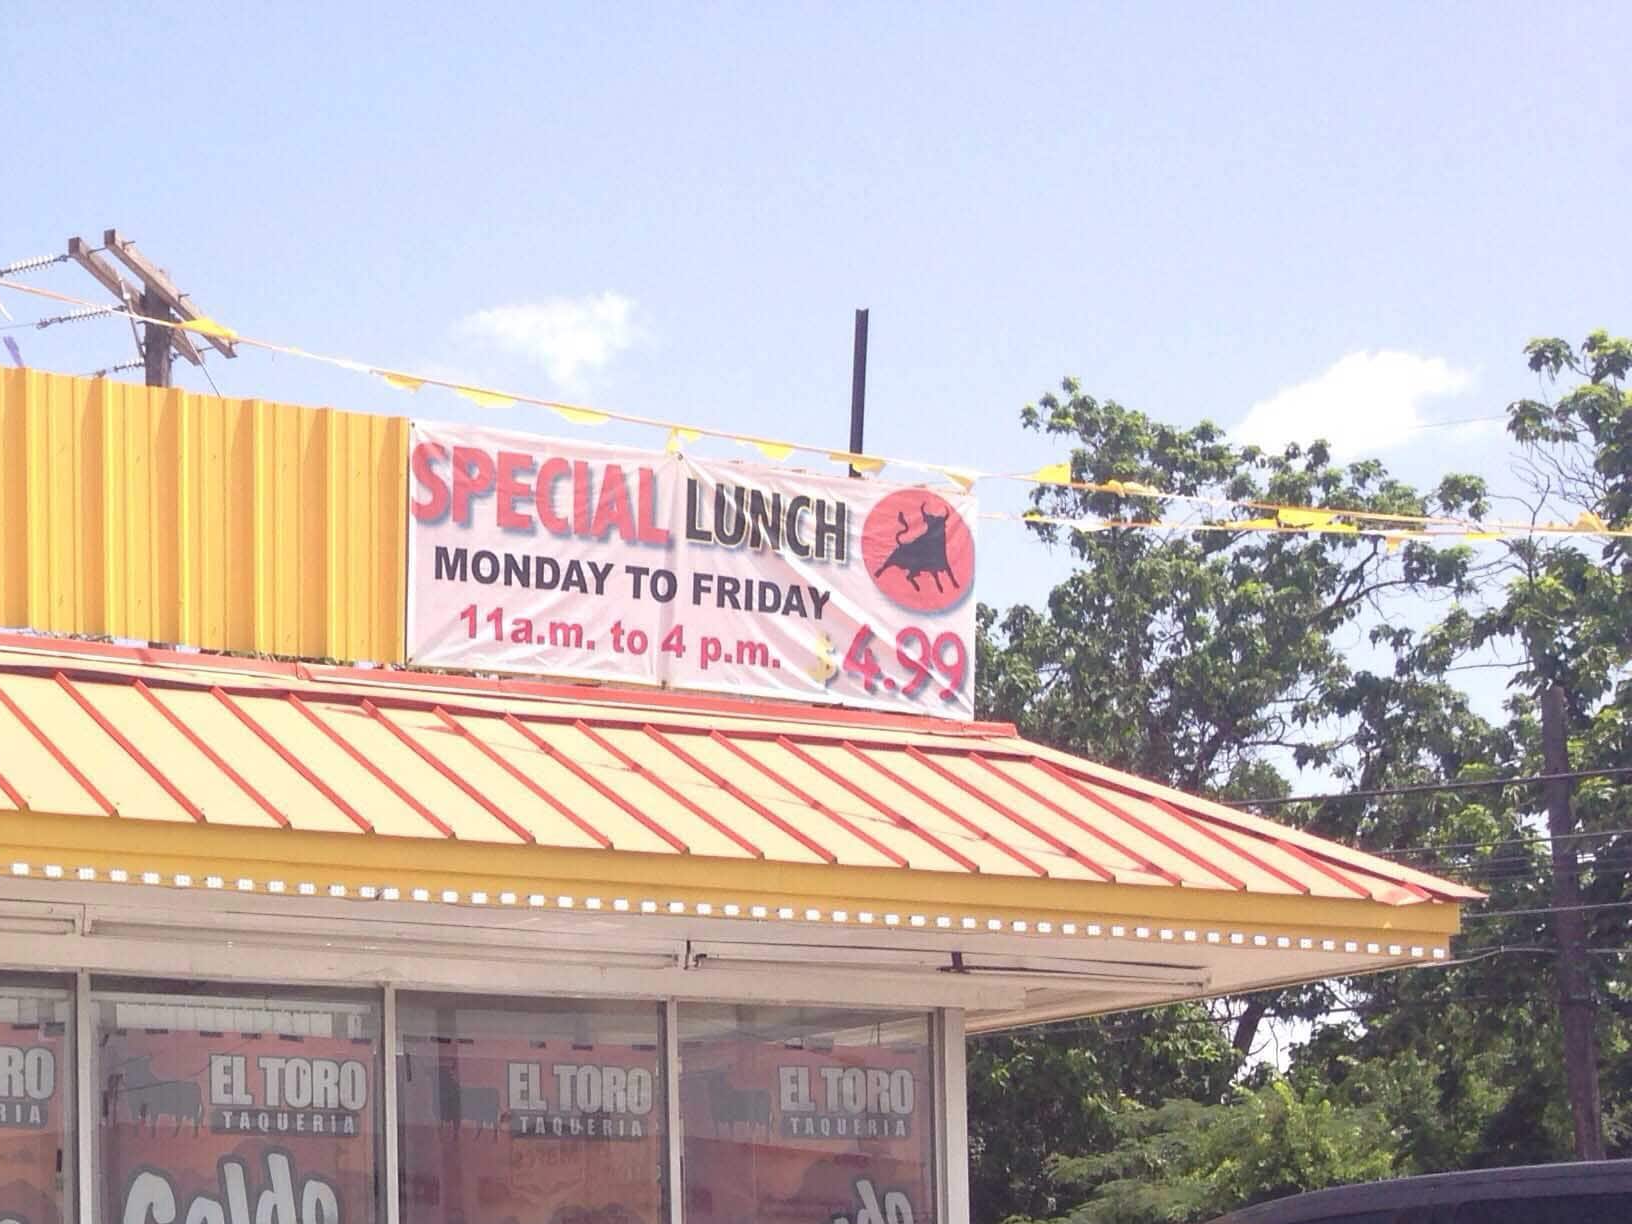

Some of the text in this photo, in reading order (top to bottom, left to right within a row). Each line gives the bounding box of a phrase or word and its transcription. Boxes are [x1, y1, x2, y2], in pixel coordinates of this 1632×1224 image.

[412, 441, 848, 562] SPECIAL LUNCH
[434, 545, 833, 621] MONDAY TO FRIDAY
[610, 620, 650, 658] to
[661, 625, 687, 661] 4
[699, 633, 782, 671] p.m.
[209, 1054, 367, 1111] EL TORO
[507, 1062, 653, 1115] EL TORO
[778, 1065, 915, 1115] EL TORO
[222, 1110, 357, 1136] TAQUERIA
[518, 1115, 643, 1138] TAQUERIA
[789, 1115, 907, 1138] TAQUERIA
